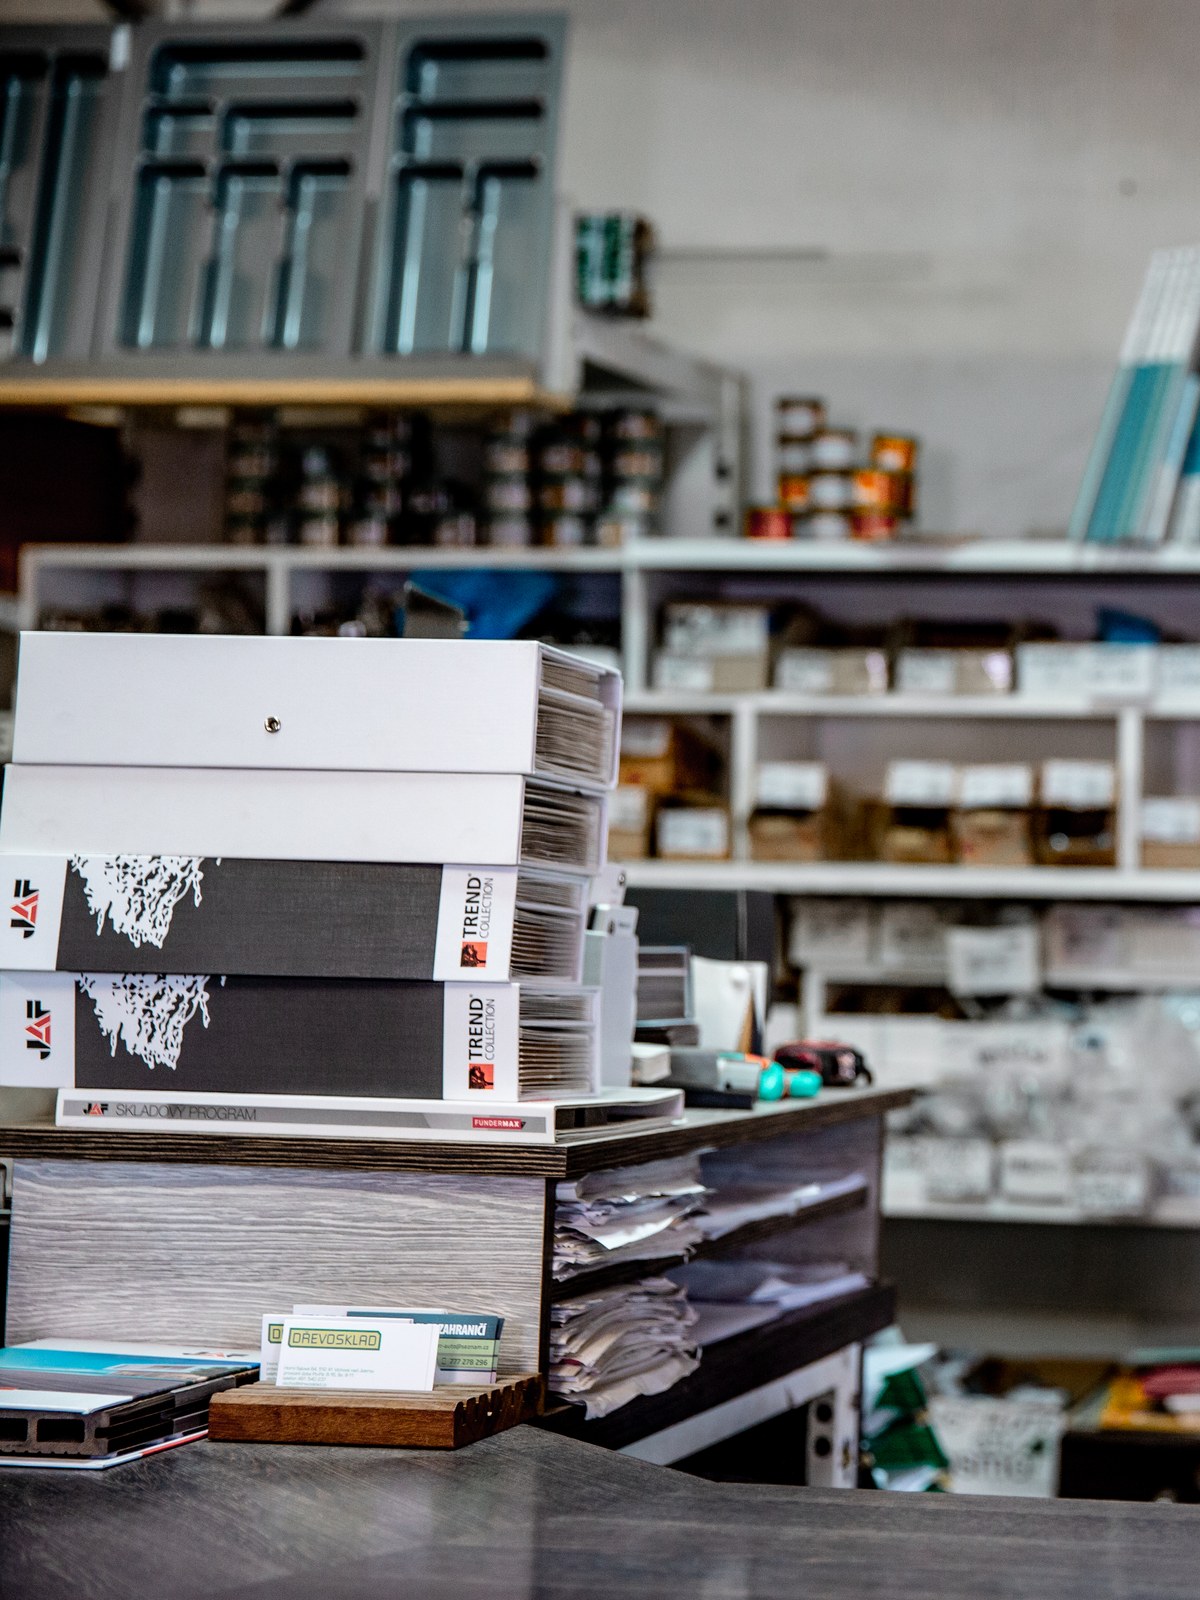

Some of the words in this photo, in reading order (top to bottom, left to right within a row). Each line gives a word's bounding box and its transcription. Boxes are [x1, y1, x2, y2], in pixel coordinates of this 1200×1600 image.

[10, 879, 40, 939] JAF
[462, 877, 482, 939] TREND
[479, 877, 494, 939] COLLECTION
[25, 1000, 51, 1060] JAF
[468, 998, 483, 1061] TREND
[484, 998, 495, 1061] COLLECTION
[83, 1103, 109, 1116] JAF
[188, 1105, 257, 1121] PROGRAM
[474, 1118, 520, 1128] FUNDERMAX
[292, 1331, 377, 1347] DŘEVOSKLAD
[449, 1357, 461, 1365] 777
[462, 1358, 474, 1366] 278
[475, 1358, 488, 1366] 296
